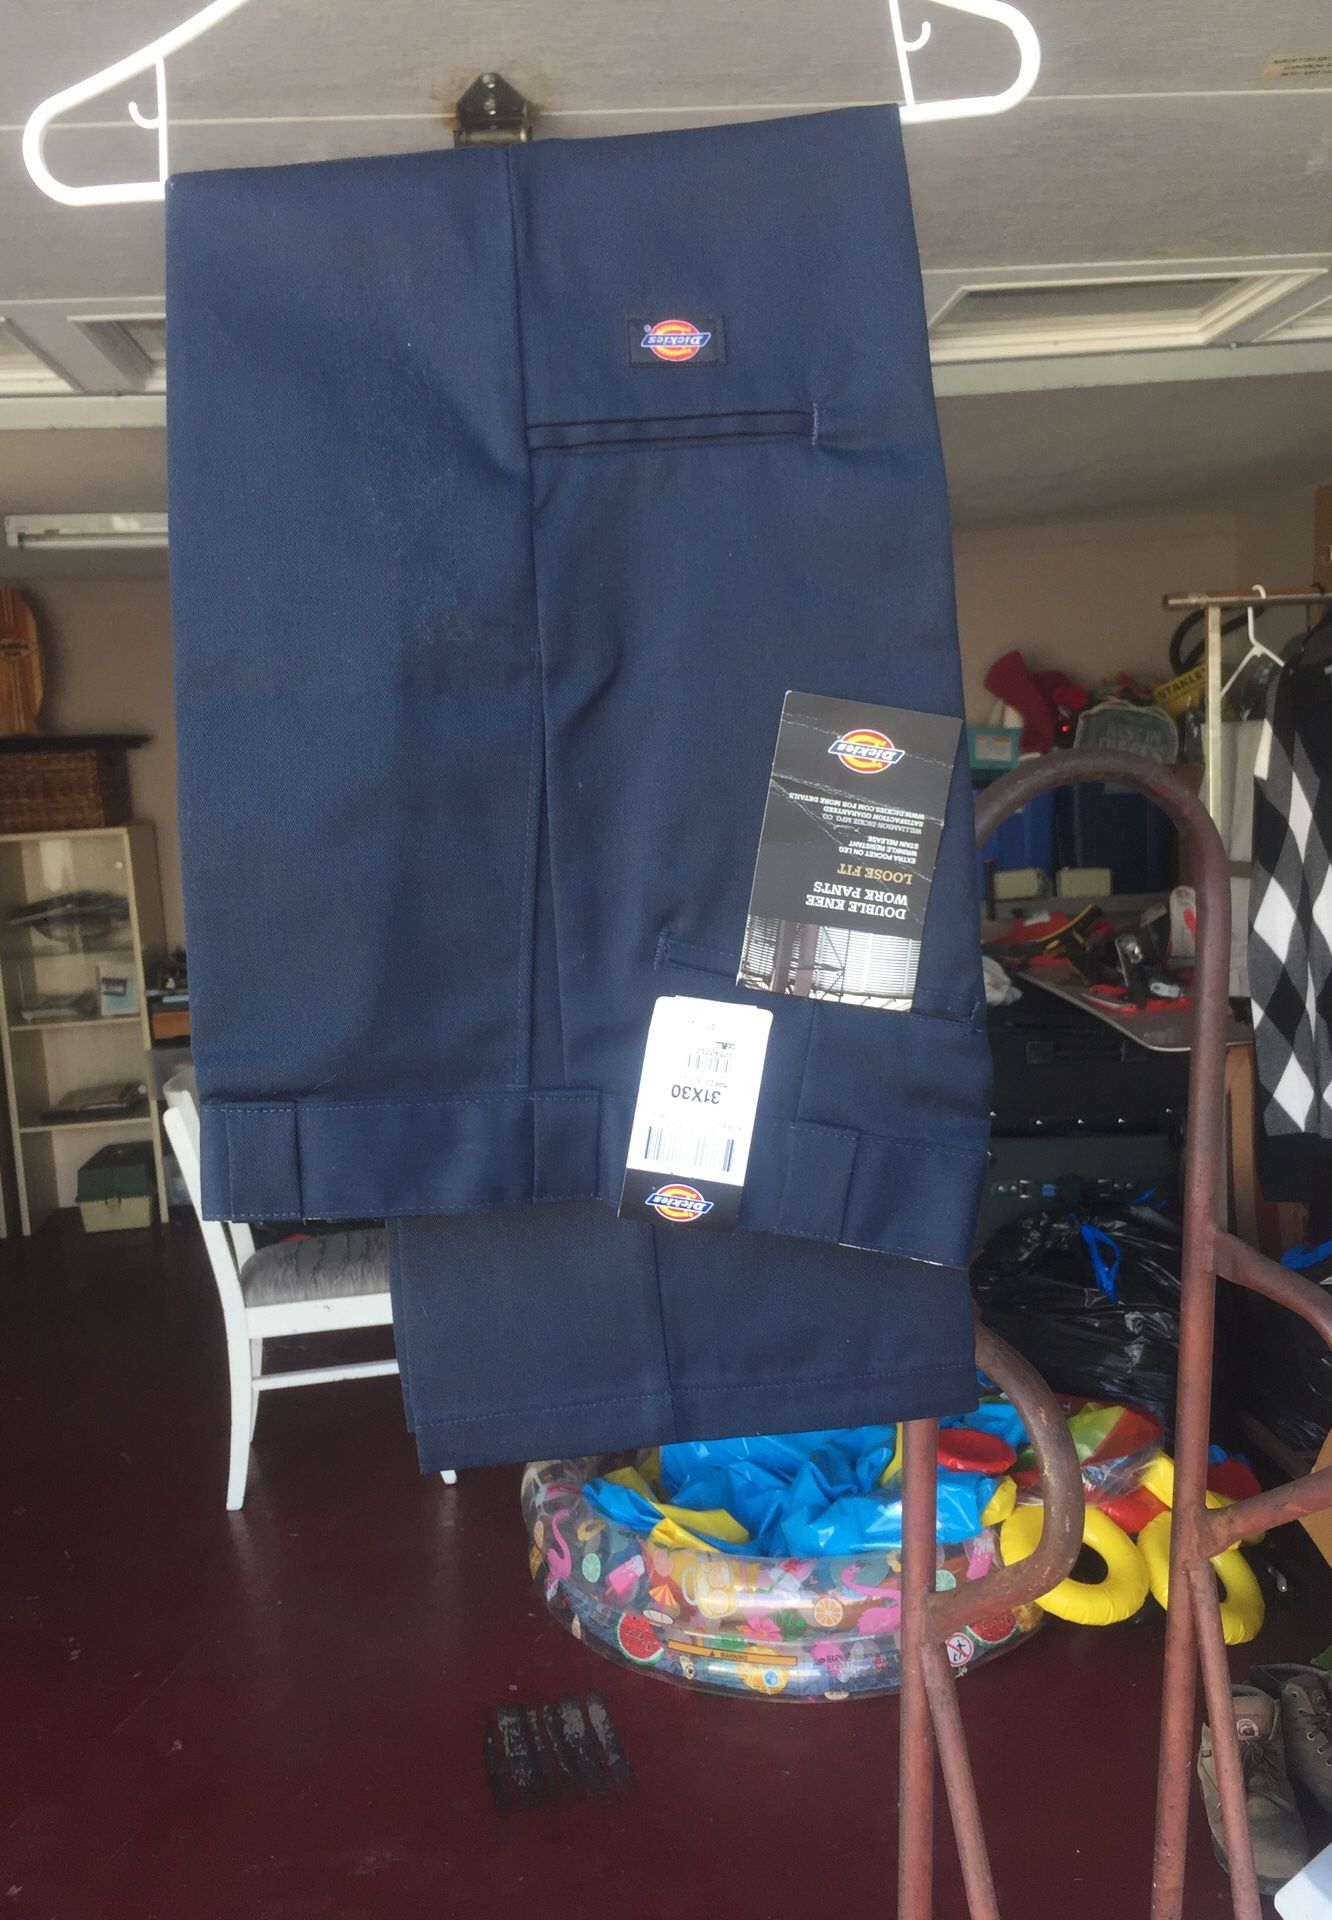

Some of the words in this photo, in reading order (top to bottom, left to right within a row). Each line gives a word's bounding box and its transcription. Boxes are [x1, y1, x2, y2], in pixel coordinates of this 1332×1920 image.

[648, 336, 703, 345] Dickies
[836, 743, 897, 761] Dickies
[788, 792, 819, 803] DETAILS
[819, 797, 841, 806] MORE
[823, 806, 872, 819] GUARANTEED
[873, 813, 924, 827] SATISFACTION
[848, 840, 885, 852] RESISTANT
[867, 836, 899, 846] RELEASE
[899, 841, 919, 849] STAIN
[838, 846, 852, 855] LEG
[866, 850, 892, 860] POCKET
[886, 846, 918, 857] WRINKLE
[893, 855, 916, 864] EXTRA
[837, 863, 862, 877] FIT
[864, 867, 912, 885] LOOSE
[813, 881, 862, 899] PANTS
[805, 894, 846, 911] KNEE
[863, 889, 908, 906] WORK
[848, 901, 906, 920] DOUBLE
[671, 1084, 721, 1105] 31X30
[653, 1195, 707, 1211] Dickies
